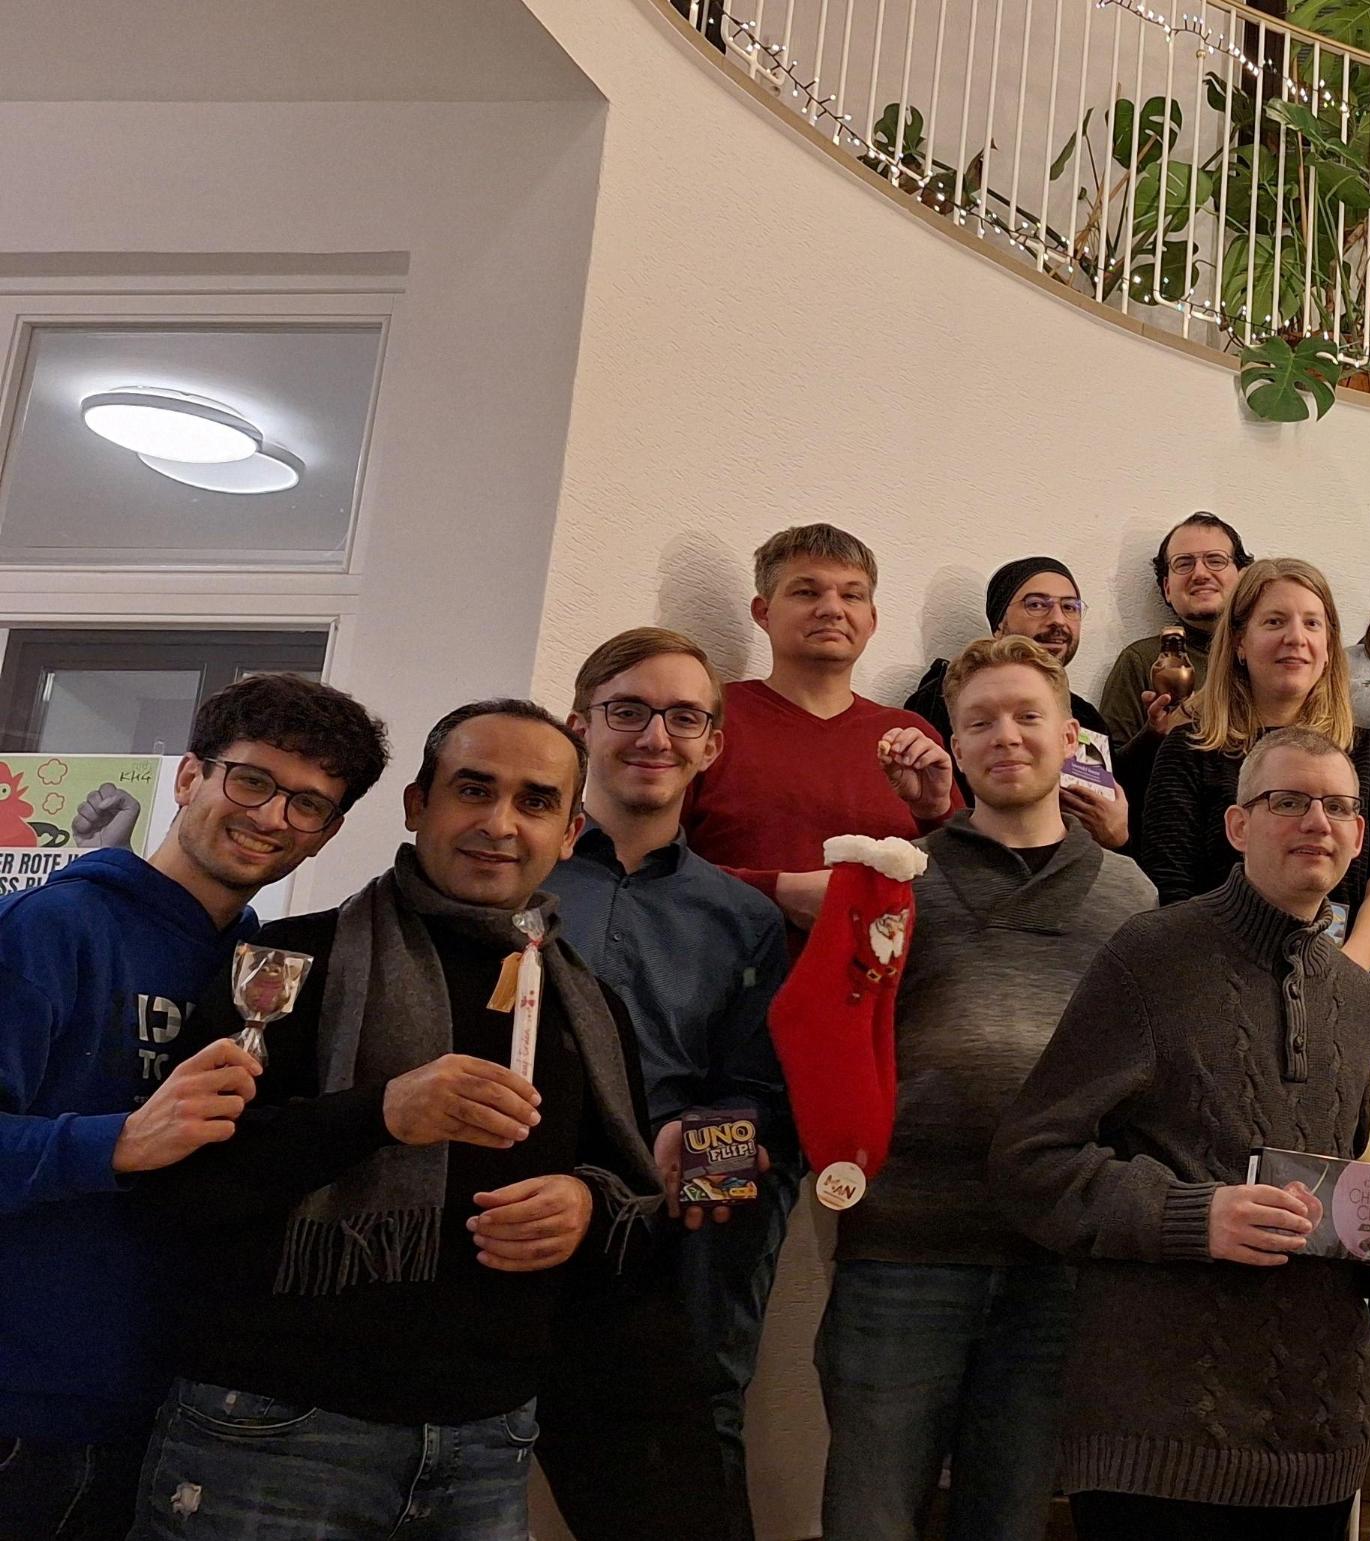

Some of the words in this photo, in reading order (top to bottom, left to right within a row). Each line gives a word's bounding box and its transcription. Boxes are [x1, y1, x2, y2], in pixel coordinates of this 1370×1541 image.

[18, 853, 62, 875] ROTE
[686, 1120, 755, 1152] UNO
[709, 1140, 756, 1162] FLIP!
